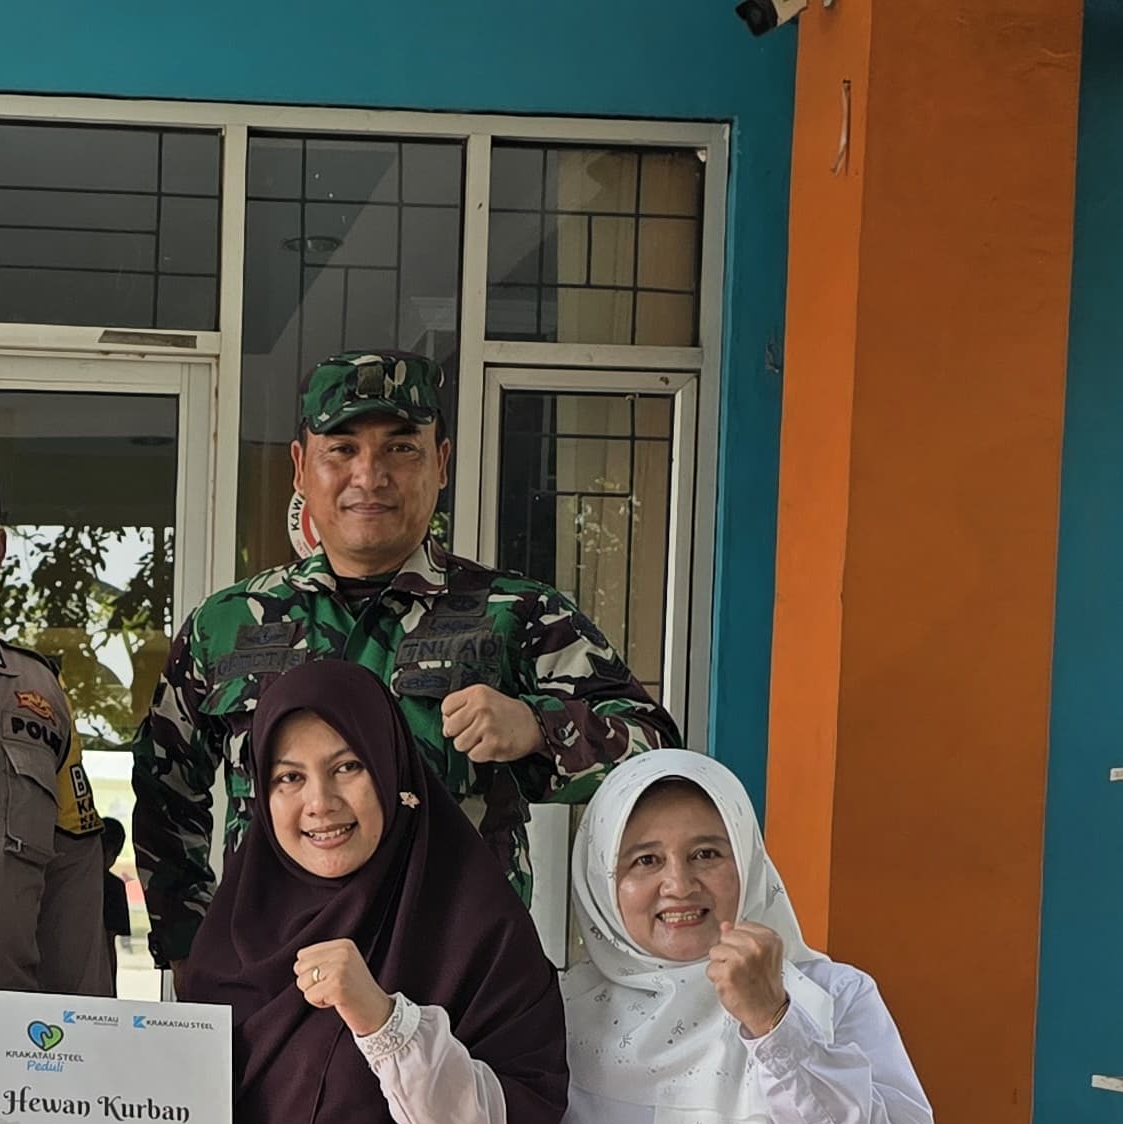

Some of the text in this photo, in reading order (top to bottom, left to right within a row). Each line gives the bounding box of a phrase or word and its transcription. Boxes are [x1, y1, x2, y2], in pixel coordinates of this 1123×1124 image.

[76, 1014, 119, 1024] KRAKATAU
[146, 1019, 214, 1031] KRAKATAU STEEL
[6, 1050, 85, 1063] KRAKATAU STEEL
[27, 1060, 64, 1073] Peduli
[2, 1086, 91, 1118] Hewan
[97, 1095, 190, 1124] Kurban
